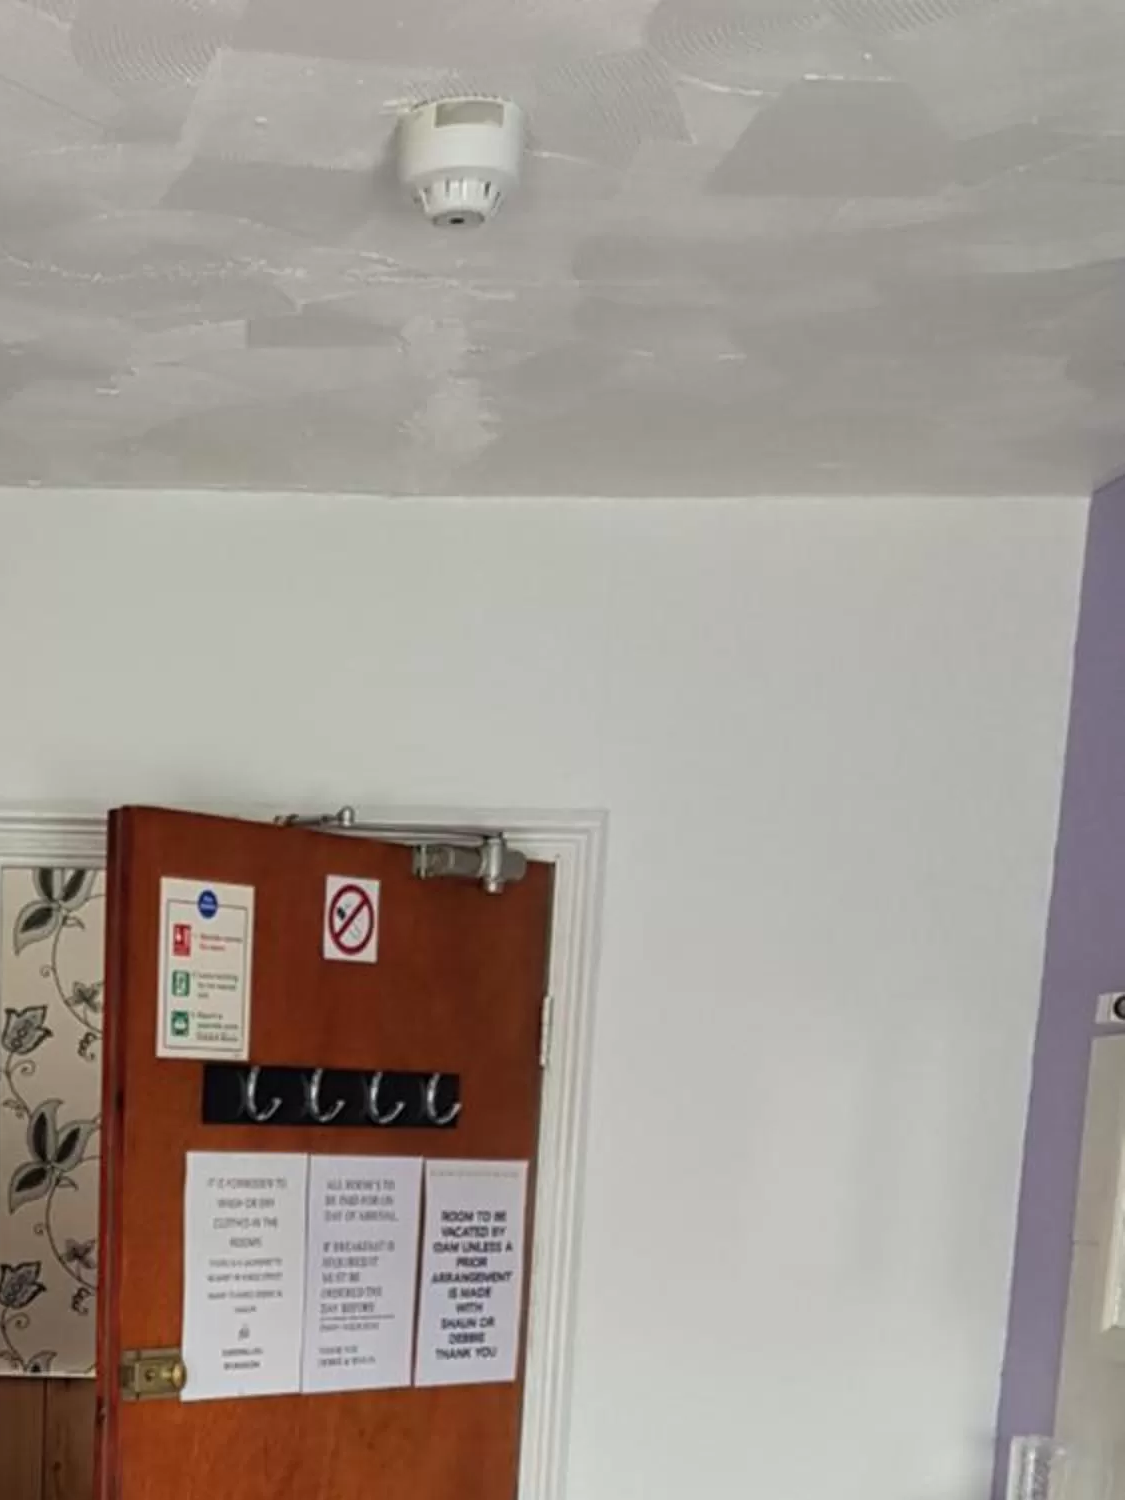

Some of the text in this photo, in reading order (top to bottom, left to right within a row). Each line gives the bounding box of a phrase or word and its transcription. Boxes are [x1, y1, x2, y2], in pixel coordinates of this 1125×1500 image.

[441, 1209, 507, 1222] ROOM TO BE
[441, 1226, 507, 1238] VACATED BY
[461, 1241, 502, 1254] UNLESS
[504, 1241, 514, 1254] A
[456, 1256, 488, 1269] PRIOR
[431, 1271, 513, 1284] ARRANGEMENT
[447, 1286, 491, 1299] IS MADE
[456, 1302, 484, 1314] WITH
[440, 1316, 495, 1330] SHAUN OR
[448, 1332, 486, 1344] DEBBIE
[435, 1346, 498, 1360] THANK YOU
